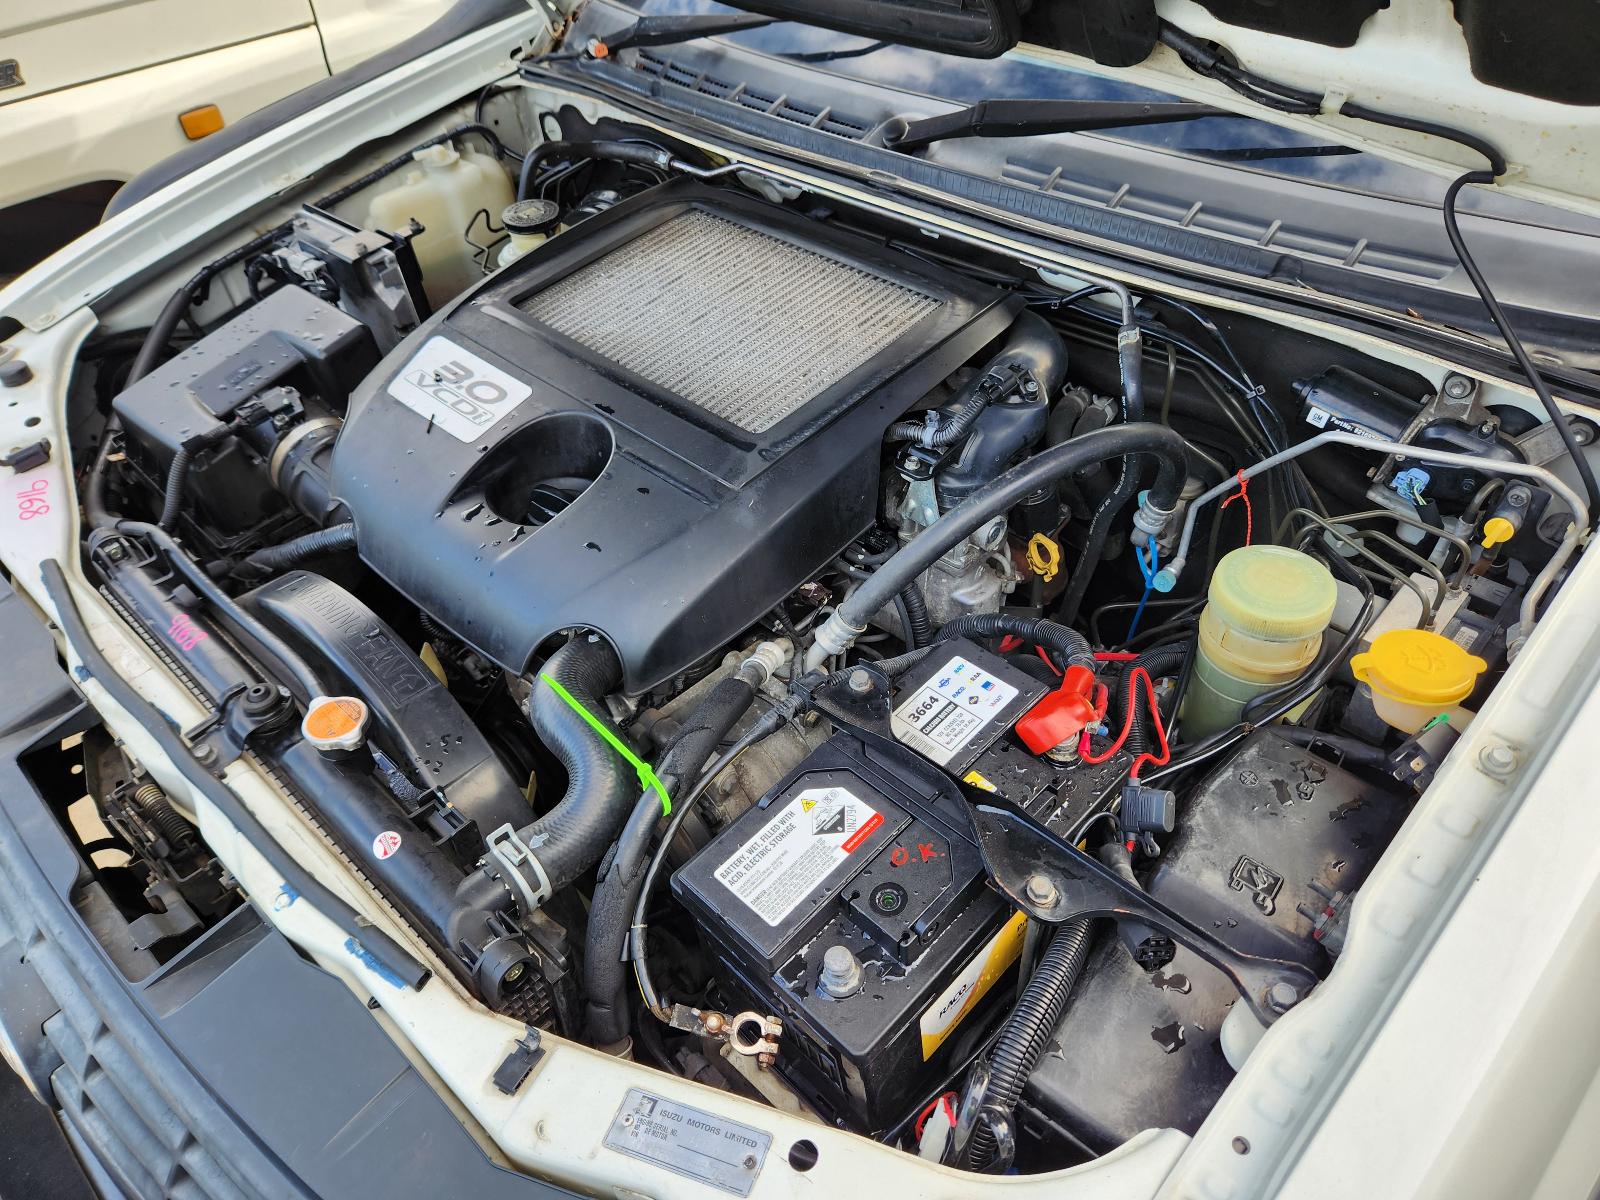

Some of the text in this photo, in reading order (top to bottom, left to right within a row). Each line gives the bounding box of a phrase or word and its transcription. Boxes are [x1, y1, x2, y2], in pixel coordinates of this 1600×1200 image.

[416, 372, 488, 423] VCDi
[433, 360, 508, 404] 3.0
[908, 696, 939, 722] 3664
[719, 852, 749, 880] BATTERY,
[745, 839, 763, 856] WET,
[759, 823, 781, 842] FILLED
[777, 809, 795, 826] WITH
[727, 869, 746, 886] ACID,
[743, 845, 772, 871] ELECTRIC
[768, 822, 796, 848] STORAGE
[939, 983, 968, 1018] RACQ
[659, 1109, 758, 1148] ISUZU MOTORS LIMITED
